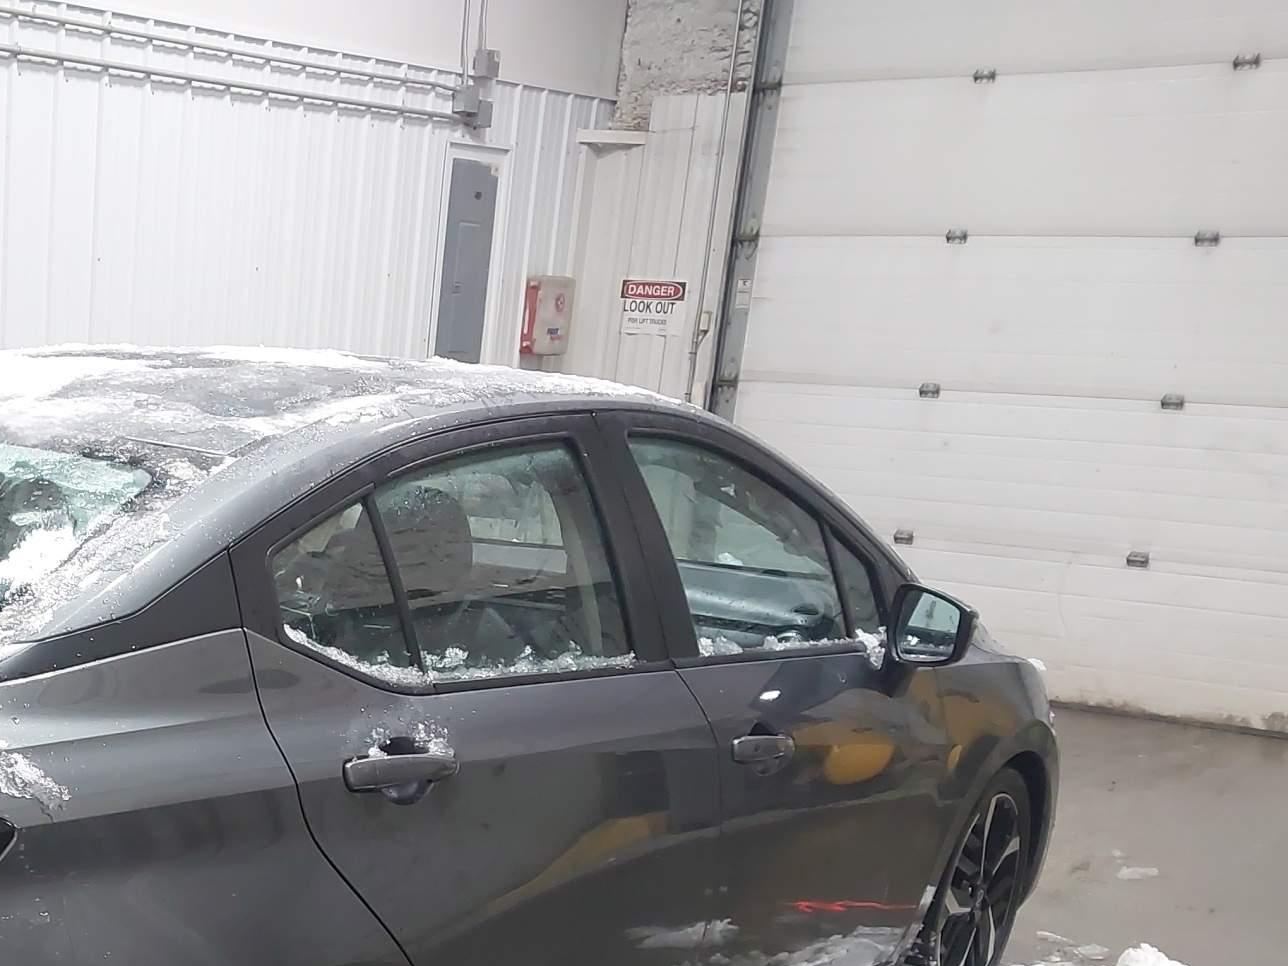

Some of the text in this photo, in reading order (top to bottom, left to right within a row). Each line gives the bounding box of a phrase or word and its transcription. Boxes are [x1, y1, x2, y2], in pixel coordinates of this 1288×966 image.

[628, 284, 675, 297] DANGER
[623, 299, 676, 314] LOOK OUT
